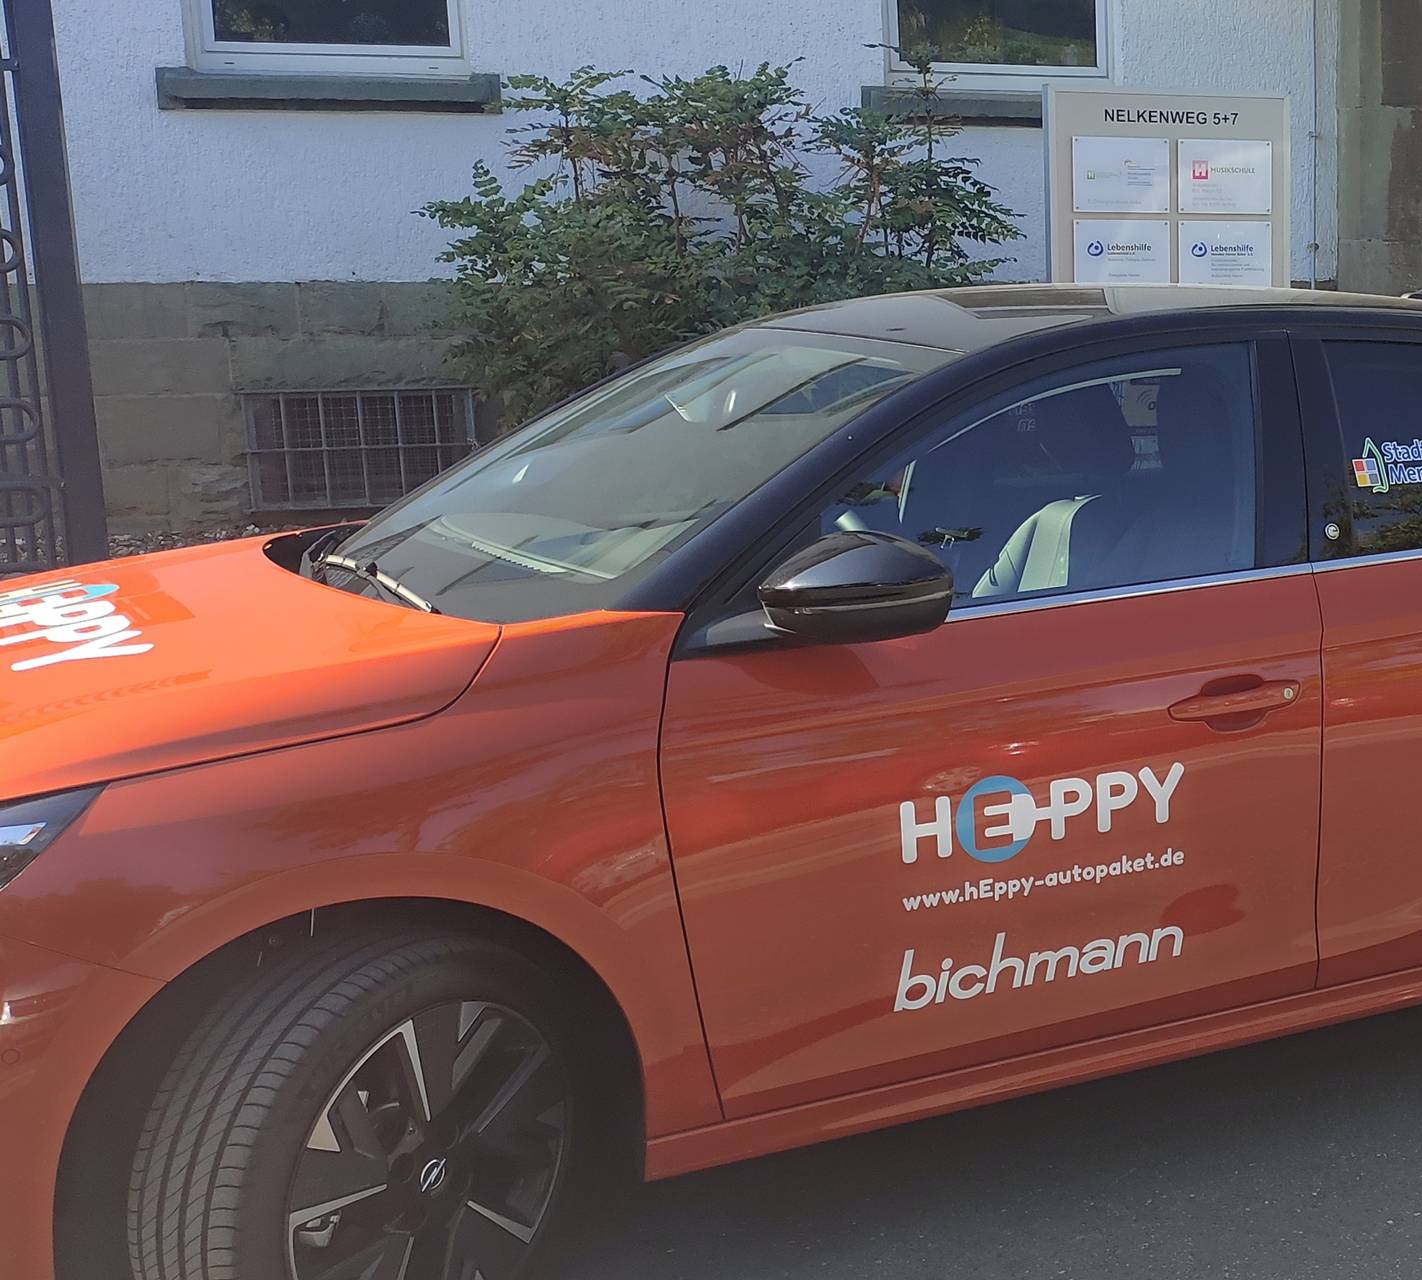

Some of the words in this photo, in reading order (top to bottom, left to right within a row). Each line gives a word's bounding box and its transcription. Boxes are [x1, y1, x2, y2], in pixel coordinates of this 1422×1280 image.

[1104, 108, 1208, 125] NELKENWEG
[1212, 112, 1239, 125] 5+7
[1107, 243, 1152, 252] Lebenshilfe
[1210, 244, 1254, 252] Lebenshilfe
[902, 847, 1186, 912] www.hEppy-autopaket.de
[893, 925, 1184, 1012] bichmann
